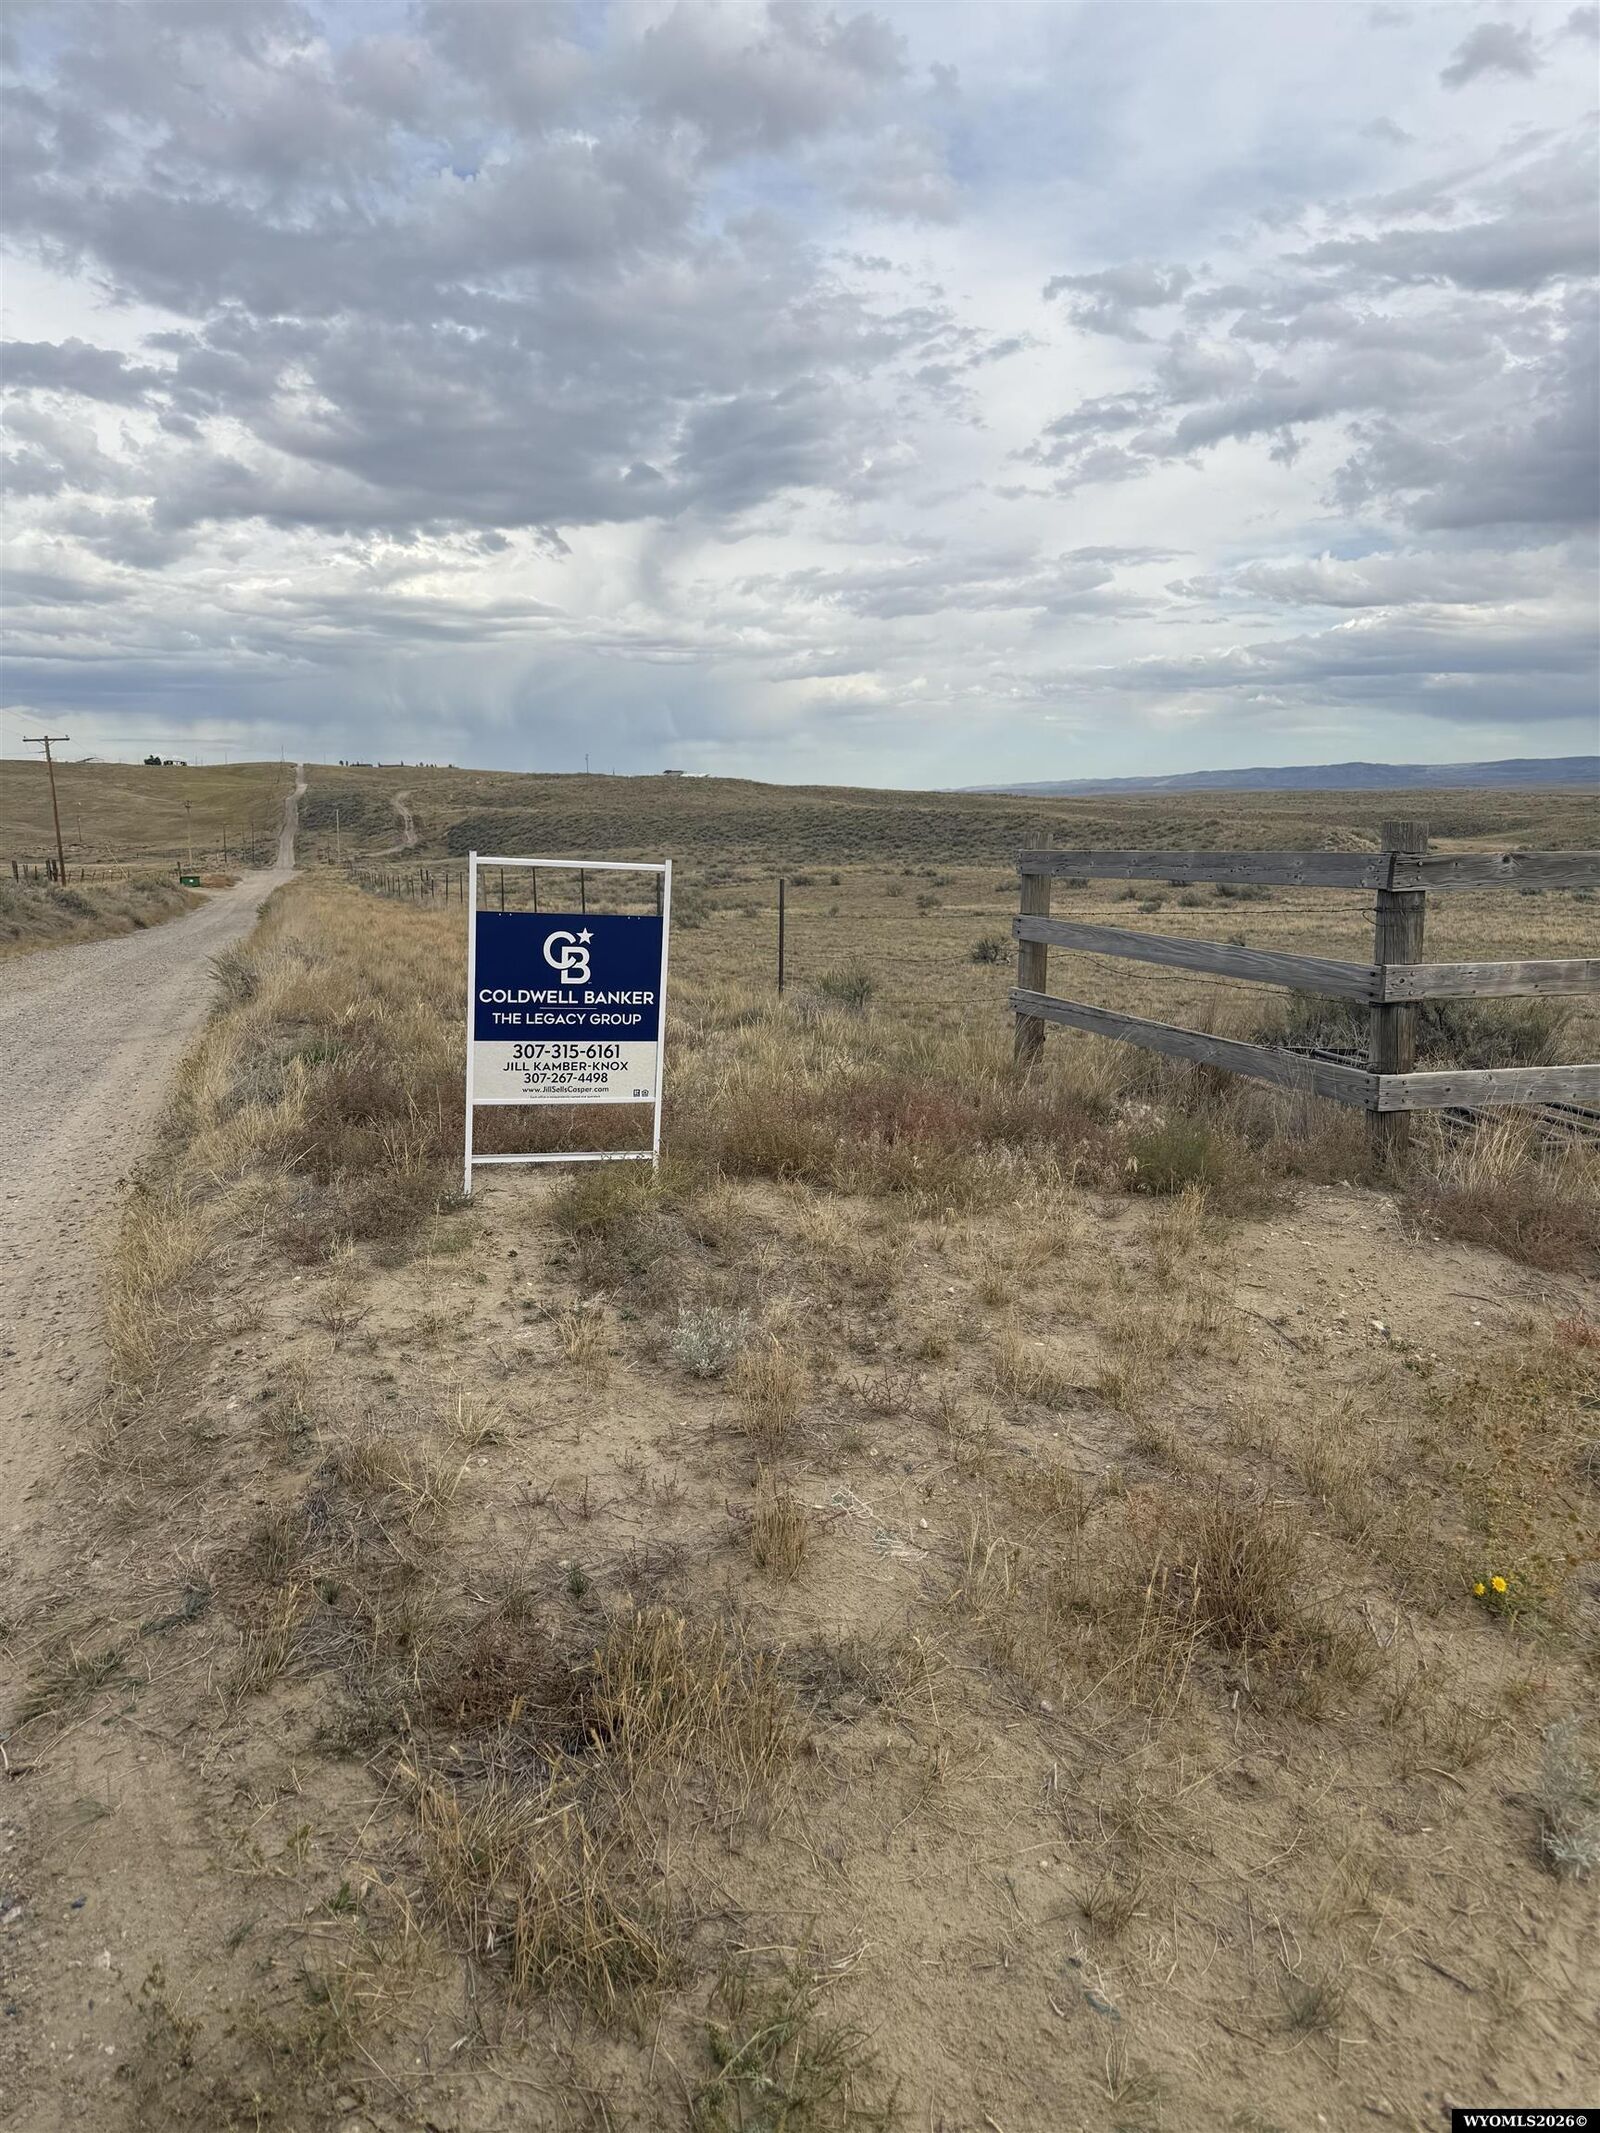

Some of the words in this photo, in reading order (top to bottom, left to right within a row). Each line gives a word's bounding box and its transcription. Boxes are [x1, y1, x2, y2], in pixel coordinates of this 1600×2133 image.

[543, 930, 591, 984] CB
[479, 989, 578, 1004] COLDWELL
[584, 991, 654, 1005] BANKER
[492, 1012, 522, 1025] THE
[526, 1013, 586, 1025] LEGACY
[590, 1014, 642, 1025] GROUP
[513, 1044, 620, 1059] 307-315-6161
[503, 1061, 530, 1072] JILL
[533, 1061, 629, 1072] KAMBER-KNOX
[524, 1072, 608, 1083] 307-267-4498
